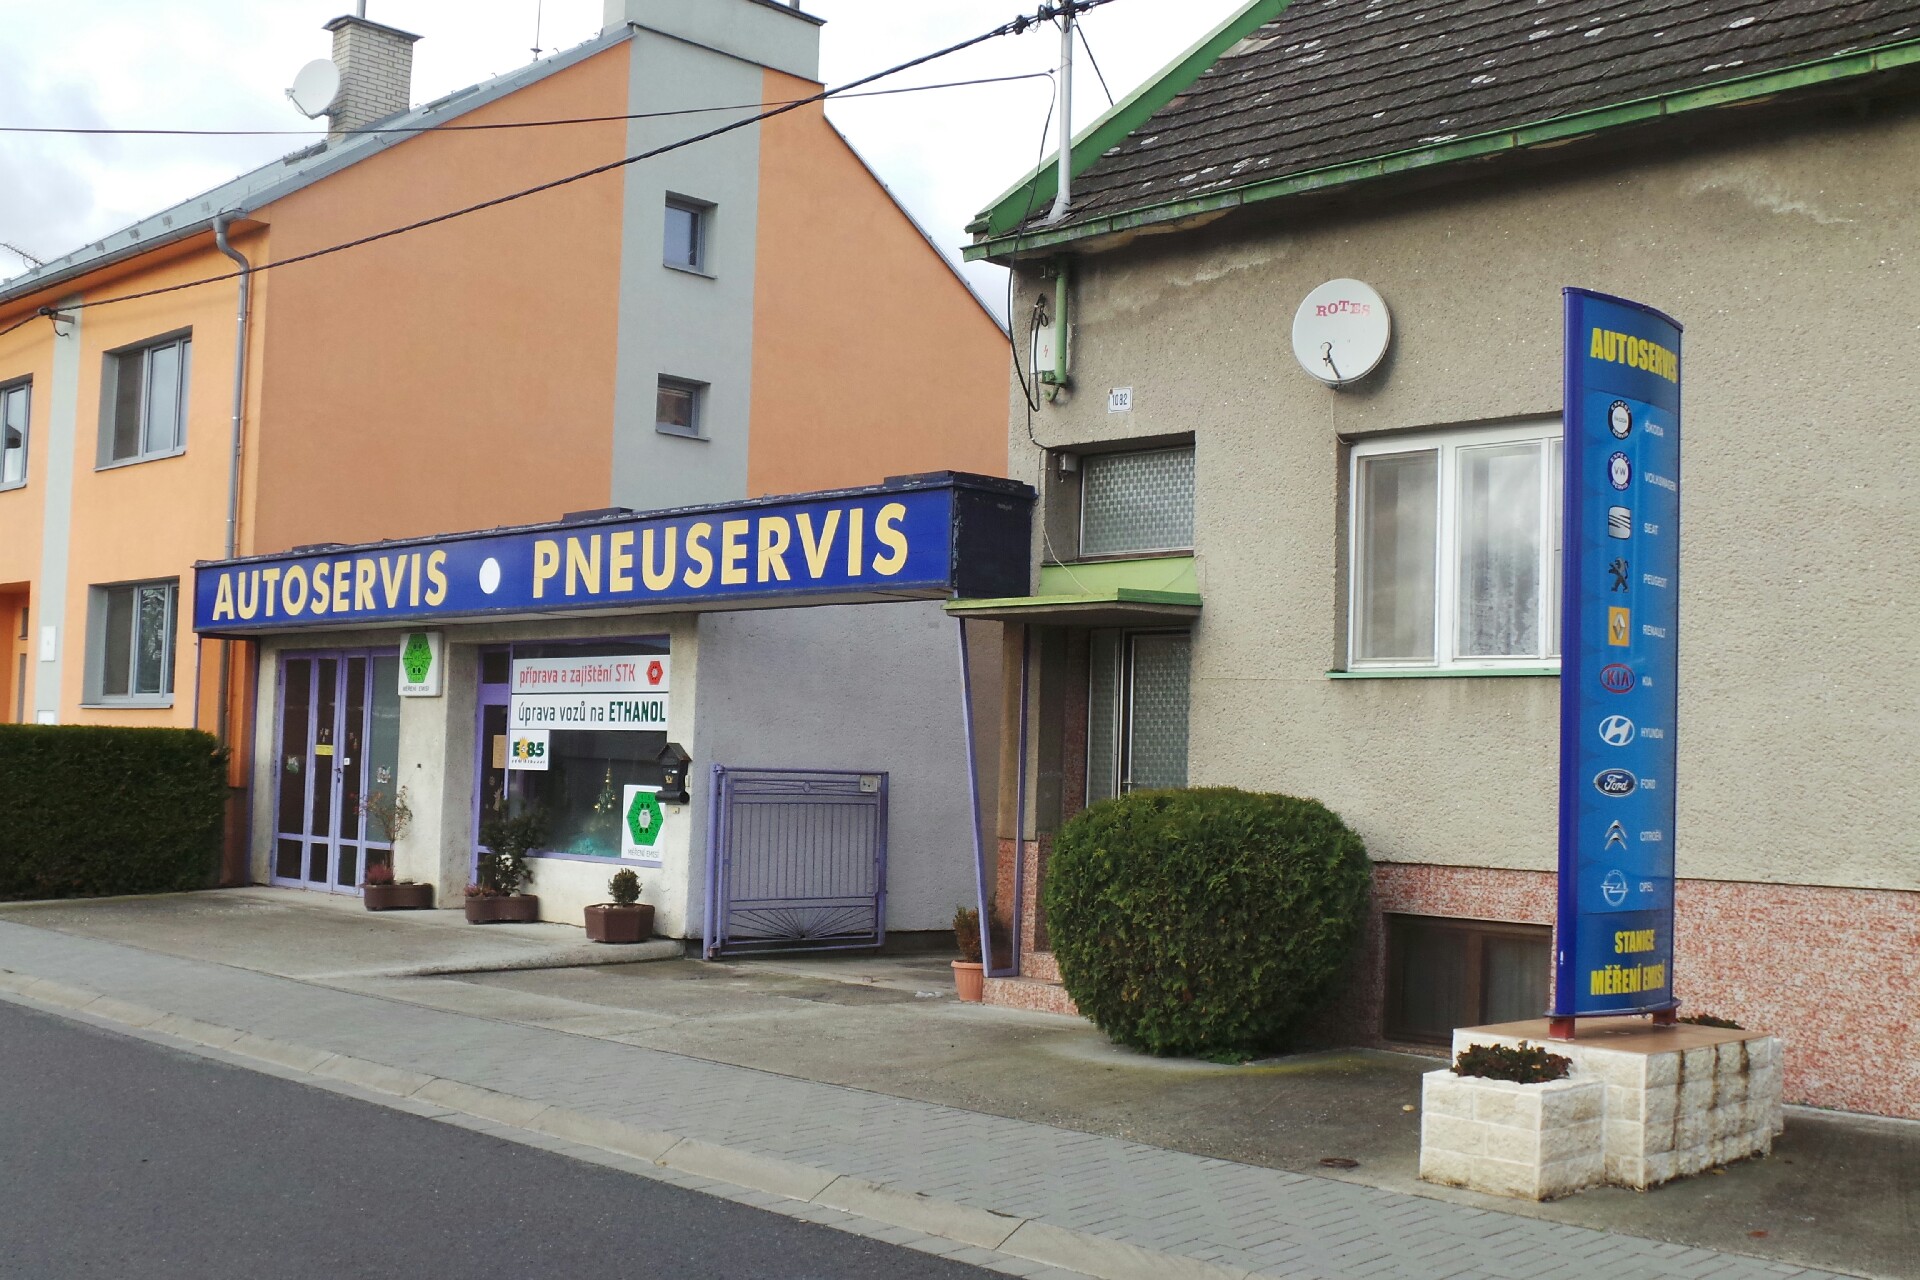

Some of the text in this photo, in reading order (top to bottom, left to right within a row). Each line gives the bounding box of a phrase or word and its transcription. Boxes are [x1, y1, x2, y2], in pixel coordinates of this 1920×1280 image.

[1316, 300, 1370, 316] ROTES
[1590, 327, 1678, 384] AUTOSERVIS
[1644, 522, 1659, 535] SEAT
[212, 502, 909, 621] AUTOSERVIS PNEUSERVIS
[519, 664, 636, 688] příprava a zajištění STK
[1607, 671, 1629, 686] KIA
[1642, 676, 1653, 686] KIA
[518, 700, 666, 726] úprava vozů na ETHANOL
[1604, 774, 1629, 791] Ford
[1641, 779, 1656, 789] FORD
[1639, 881, 1654, 893] OPEL
[1614, 929, 1655, 954] STANICE
[1591, 963, 1641, 996] MĚŘENÍ
